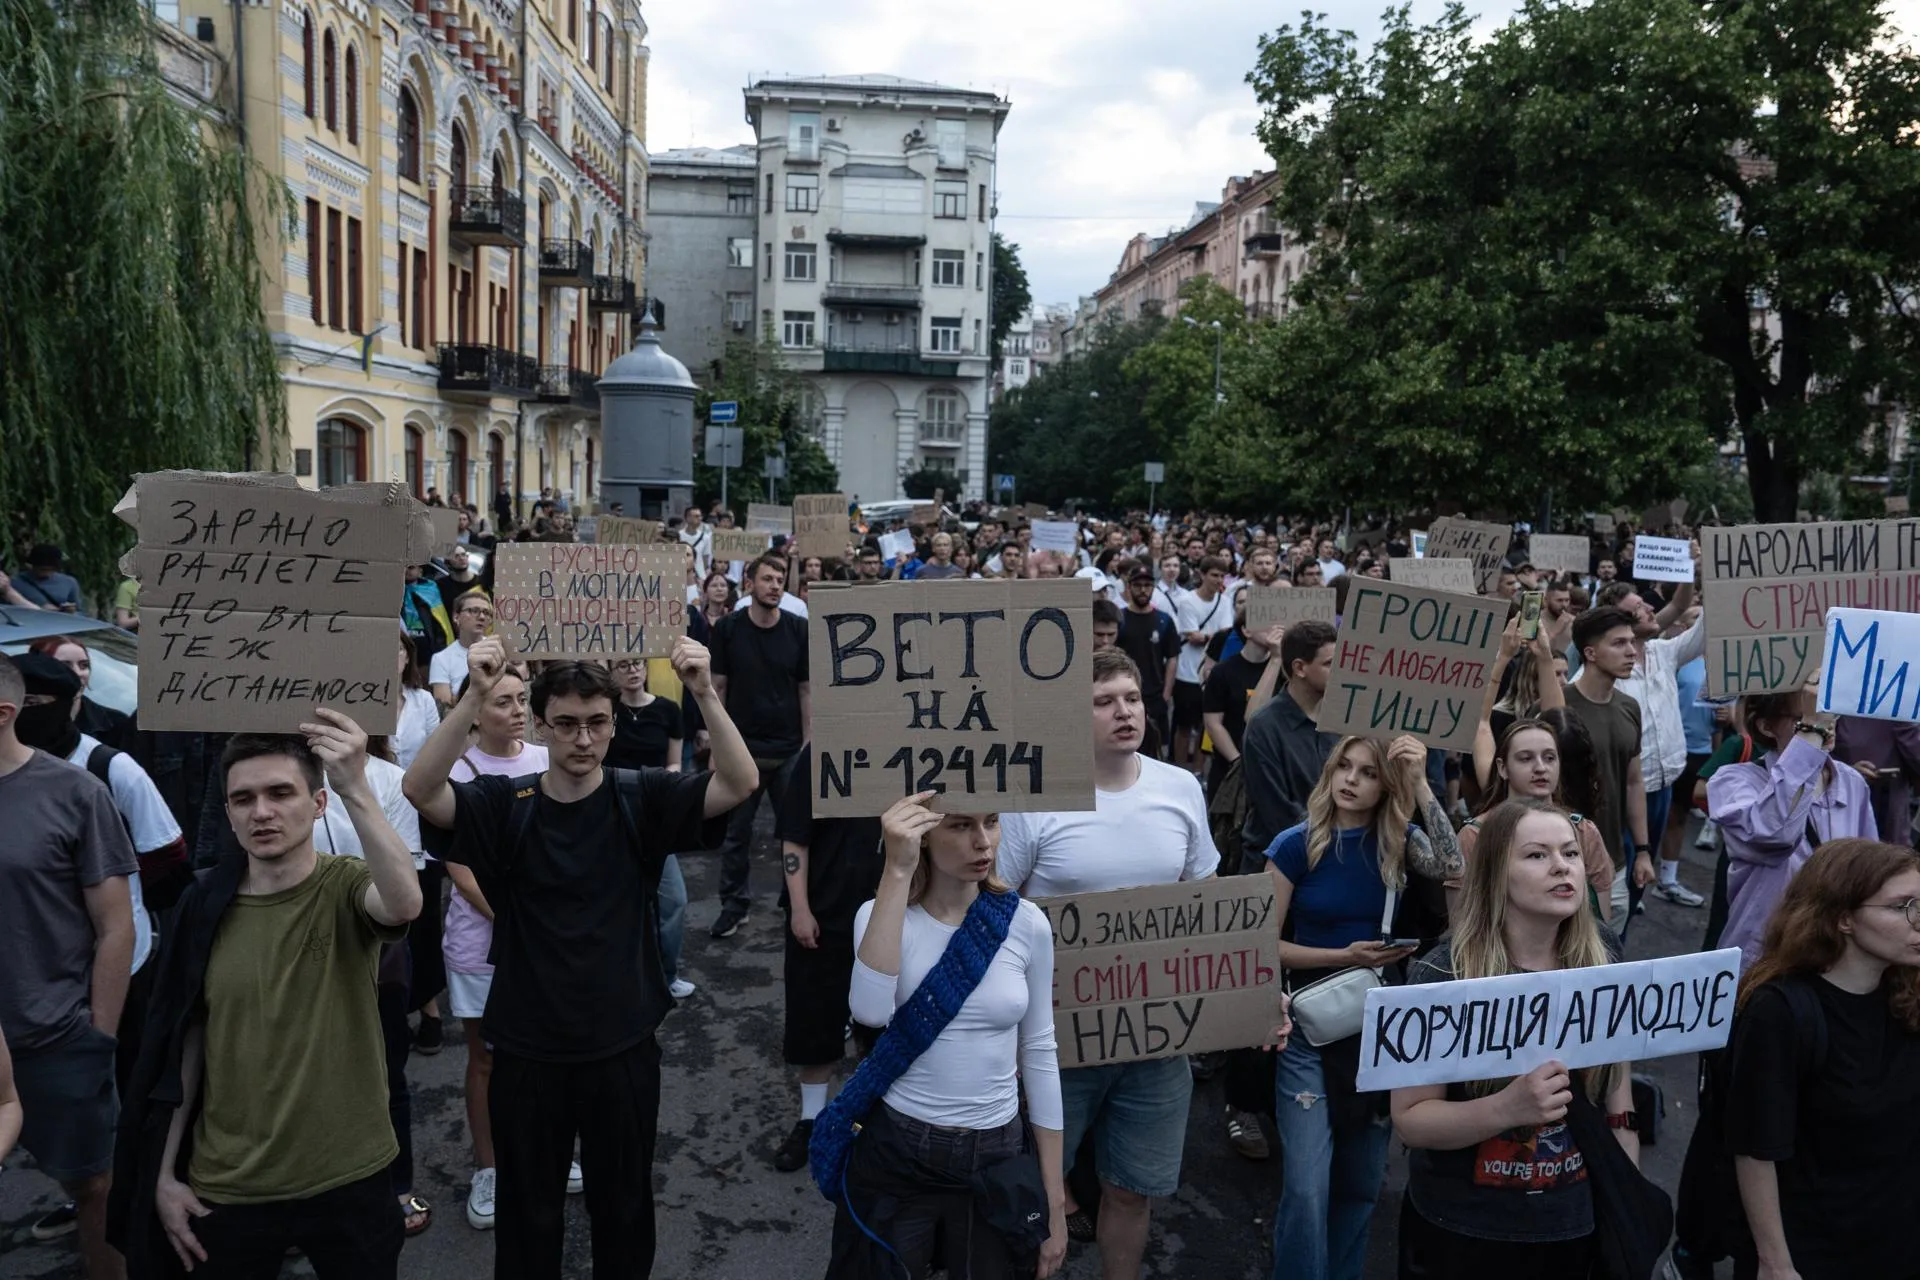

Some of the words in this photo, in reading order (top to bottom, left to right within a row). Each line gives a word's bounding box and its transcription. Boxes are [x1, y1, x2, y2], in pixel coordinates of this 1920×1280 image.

[169, 500, 350, 546] ЗАРАНО
[158, 550, 368, 585] РАДІЄТЕ
[551, 546, 638, 573] РУСНЮ
[1714, 521, 1879, 578] НАРОДНИЙ
[539, 571, 554, 598] В
[566, 572, 661, 600] МОГИЛИ
[160, 591, 239, 628] ДО
[258, 605, 349, 633] ВАС
[1352, 589, 1494, 649] ГРОШІ
[161, 633, 277, 660] ТЕЖ
[517, 621, 550, 652] ЗА
[561, 622, 645, 654] ГРАТИ
[822, 607, 1075, 687] ВЕТО
[1339, 640, 1375, 674] НЕ
[1379, 647, 1485, 690] ЛЮБЛЯТЬ
[1722, 636, 1809, 694] НАБУ
[157, 672, 391, 706] ДІСТАНЕМОСЯ!
[903, 689, 999, 731] НА
[1341, 683, 1465, 738] ТИШУ
[883, 741, 1043, 797] 12414
[1095, 892, 1204, 944] ЗАКАТАЙ
[1214, 894, 1275, 933] ГУБУ
[1164, 948, 1275, 995] ЧІПАТЬ
[1072, 998, 1205, 1063] НАБУ
[1373, 991, 1550, 1068] КОРУПЦІЯ
[1555, 970, 1735, 1050] АПЛОДУЄ
[1483, 1159, 1533, 1180] YOU'RE
[1536, 1161, 1562, 1178] TOO
